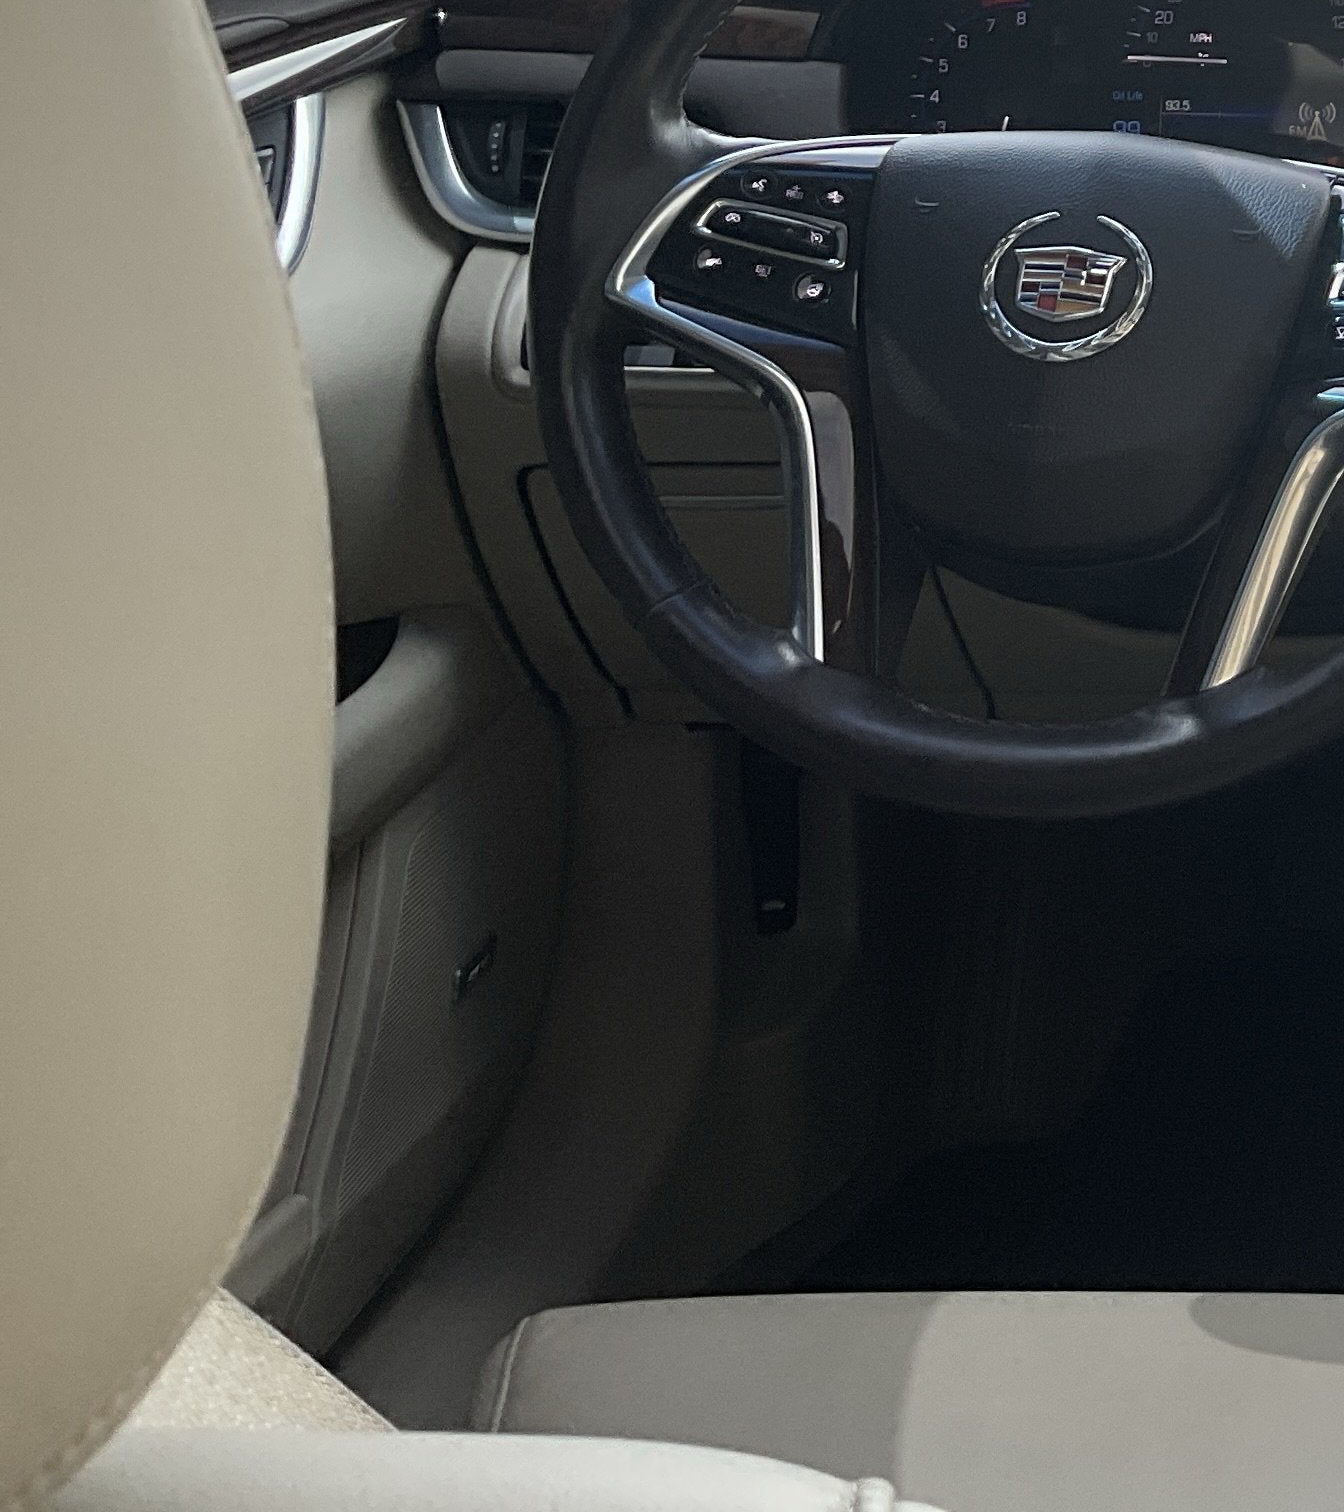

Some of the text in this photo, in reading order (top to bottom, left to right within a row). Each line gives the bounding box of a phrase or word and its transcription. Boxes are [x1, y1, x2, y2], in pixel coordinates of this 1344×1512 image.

[986, 17, 996, 33] 7
[1016, 10, 1027, 26] 8
[1154, 10, 1174, 25] 20
[957, 34, 968, 49] 6
[1146, 31, 1159, 44] 10
[1189, 33, 1213, 43] MPH
[938, 58, 949, 73] 5
[929, 90, 940, 104] 4
